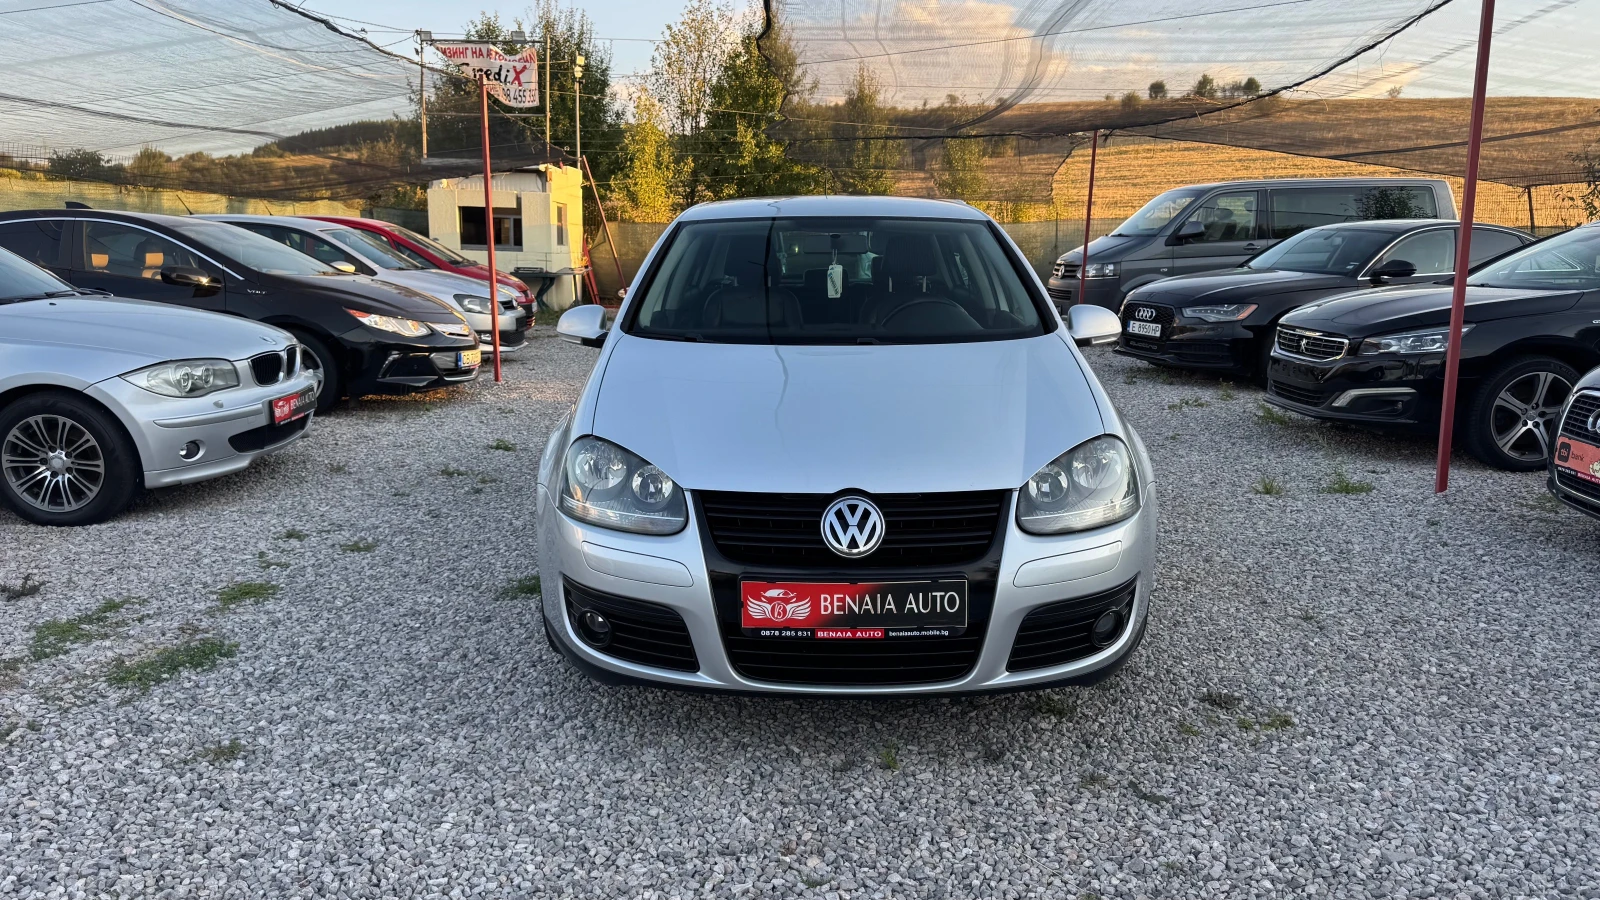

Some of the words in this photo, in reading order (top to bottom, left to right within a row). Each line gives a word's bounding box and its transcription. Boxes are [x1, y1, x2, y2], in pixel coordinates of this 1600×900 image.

[471, 47, 485, 58] НА
[513, 89, 526, 103] 455
[1571, 451, 1584, 461] bank
[820, 592, 897, 615] BENAIA
[904, 591, 960, 613] AUTO
